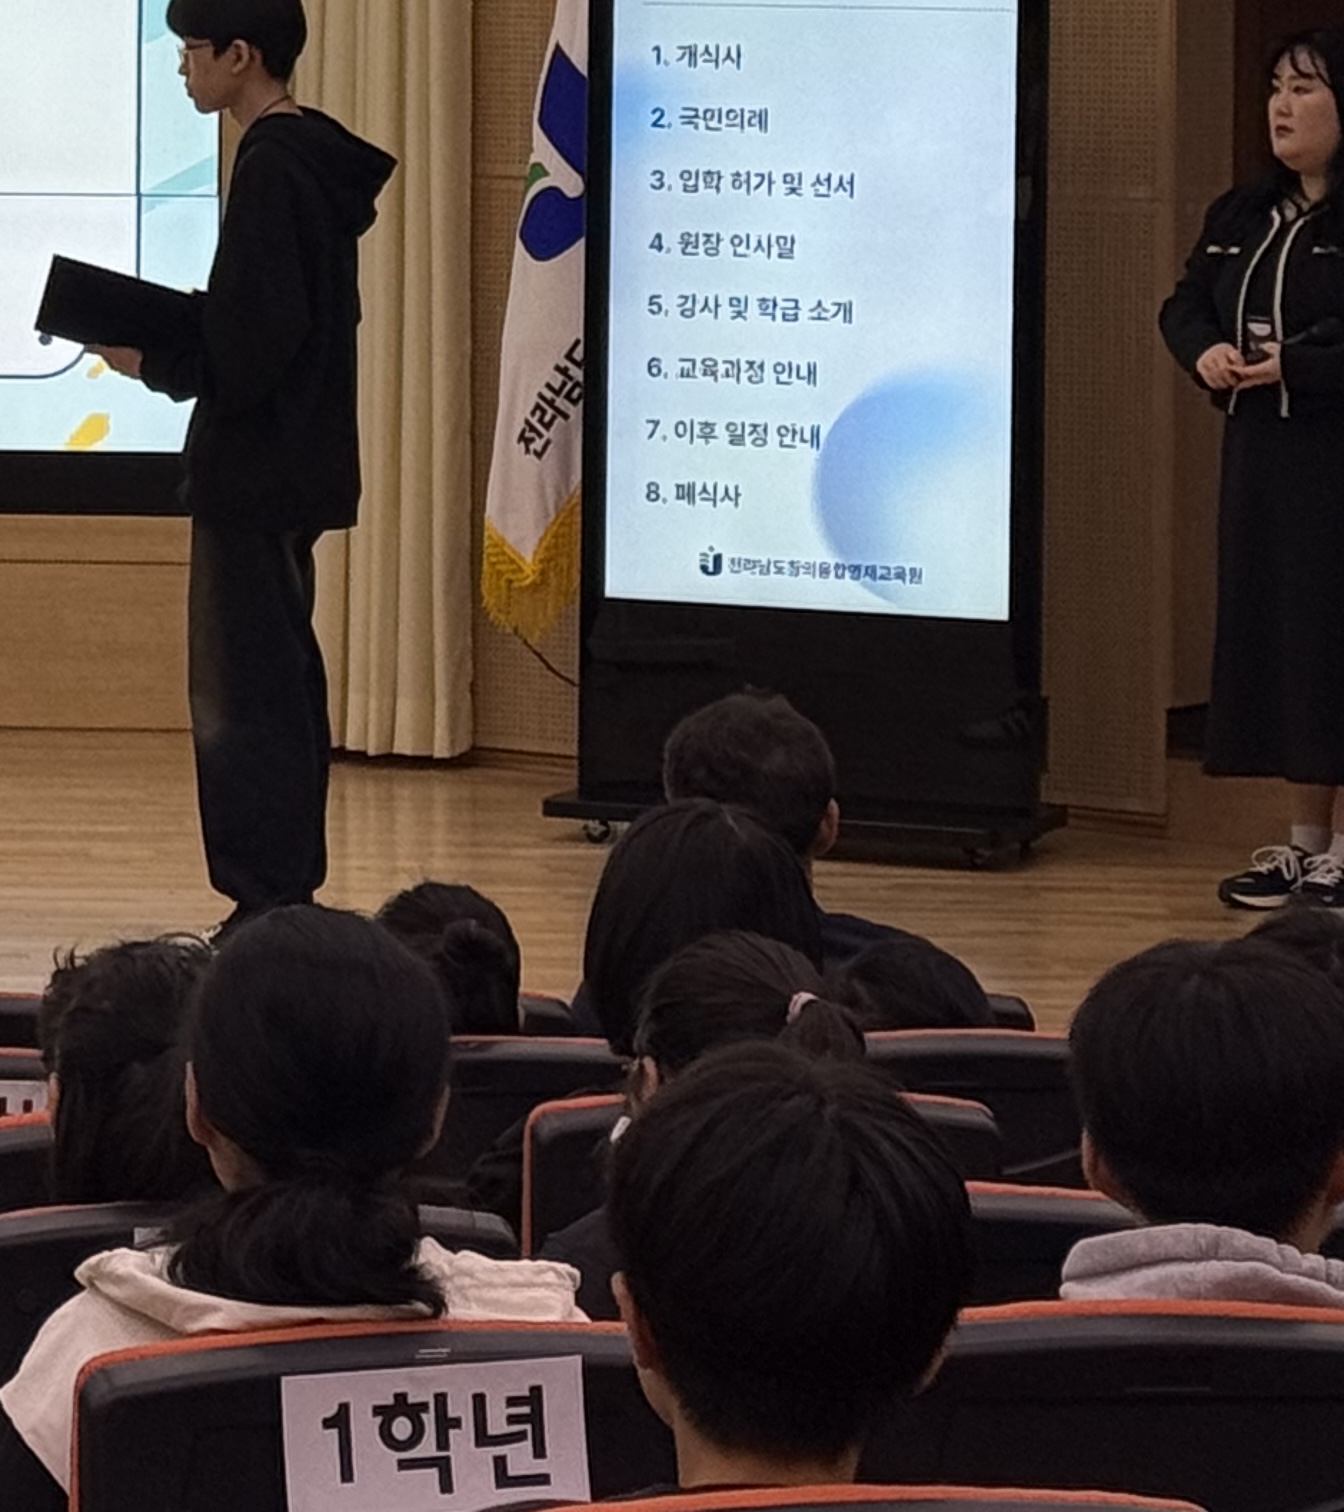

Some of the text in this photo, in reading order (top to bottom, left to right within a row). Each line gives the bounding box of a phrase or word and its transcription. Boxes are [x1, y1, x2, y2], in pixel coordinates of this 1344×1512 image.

[651, 43, 743, 71] 1. 개식사
[649, 106, 770, 134] 2. 국민의례
[649, 168, 856, 200] 3. 입학 허가 및 선서
[648, 231, 797, 261] 4. 원장 인사말
[647, 293, 854, 326] 5. 강사 및 학급 소개
[647, 356, 819, 388] 6. 교육과정 안내
[645, 418, 822, 452] 7. 이후 일정 안내
[645, 480, 669, 505] 8.
[321, 1384, 552, 1495] 1학년
